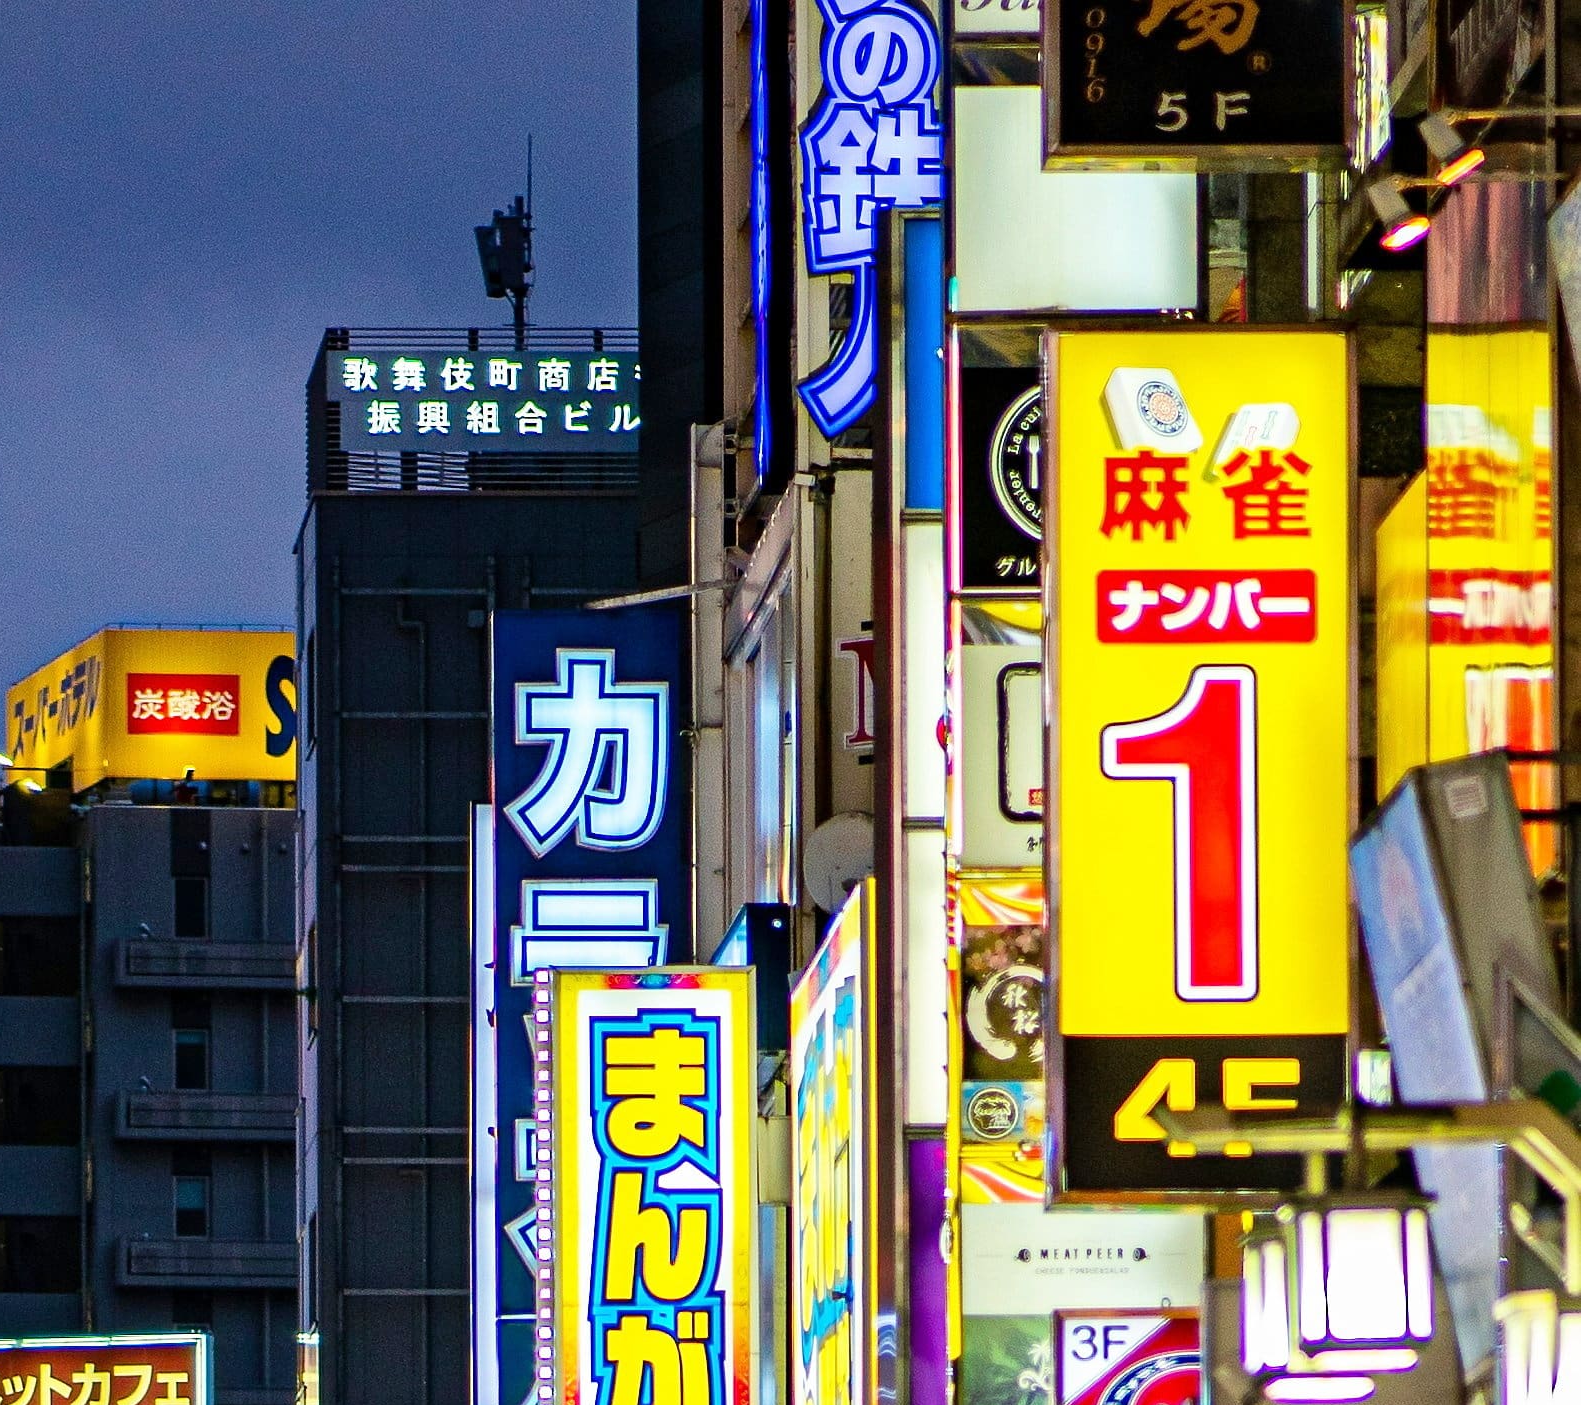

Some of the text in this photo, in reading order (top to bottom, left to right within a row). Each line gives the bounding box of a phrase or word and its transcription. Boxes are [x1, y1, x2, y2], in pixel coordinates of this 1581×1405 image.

[343, 356, 640, 392] 歌舞伎町商店
[367, 402, 641, 435] 振興組合ビル
[1099, 448, 1311, 541] 麻雀
[1107, 581, 1310, 631] ナンバー
[132, 688, 237, 721] 炭酸浴
[1101, 665, 1259, 1002] 1
[1040, 1248, 1124, 1260] MEAT PEER
[1072, 1325, 1130, 1361] 3F
